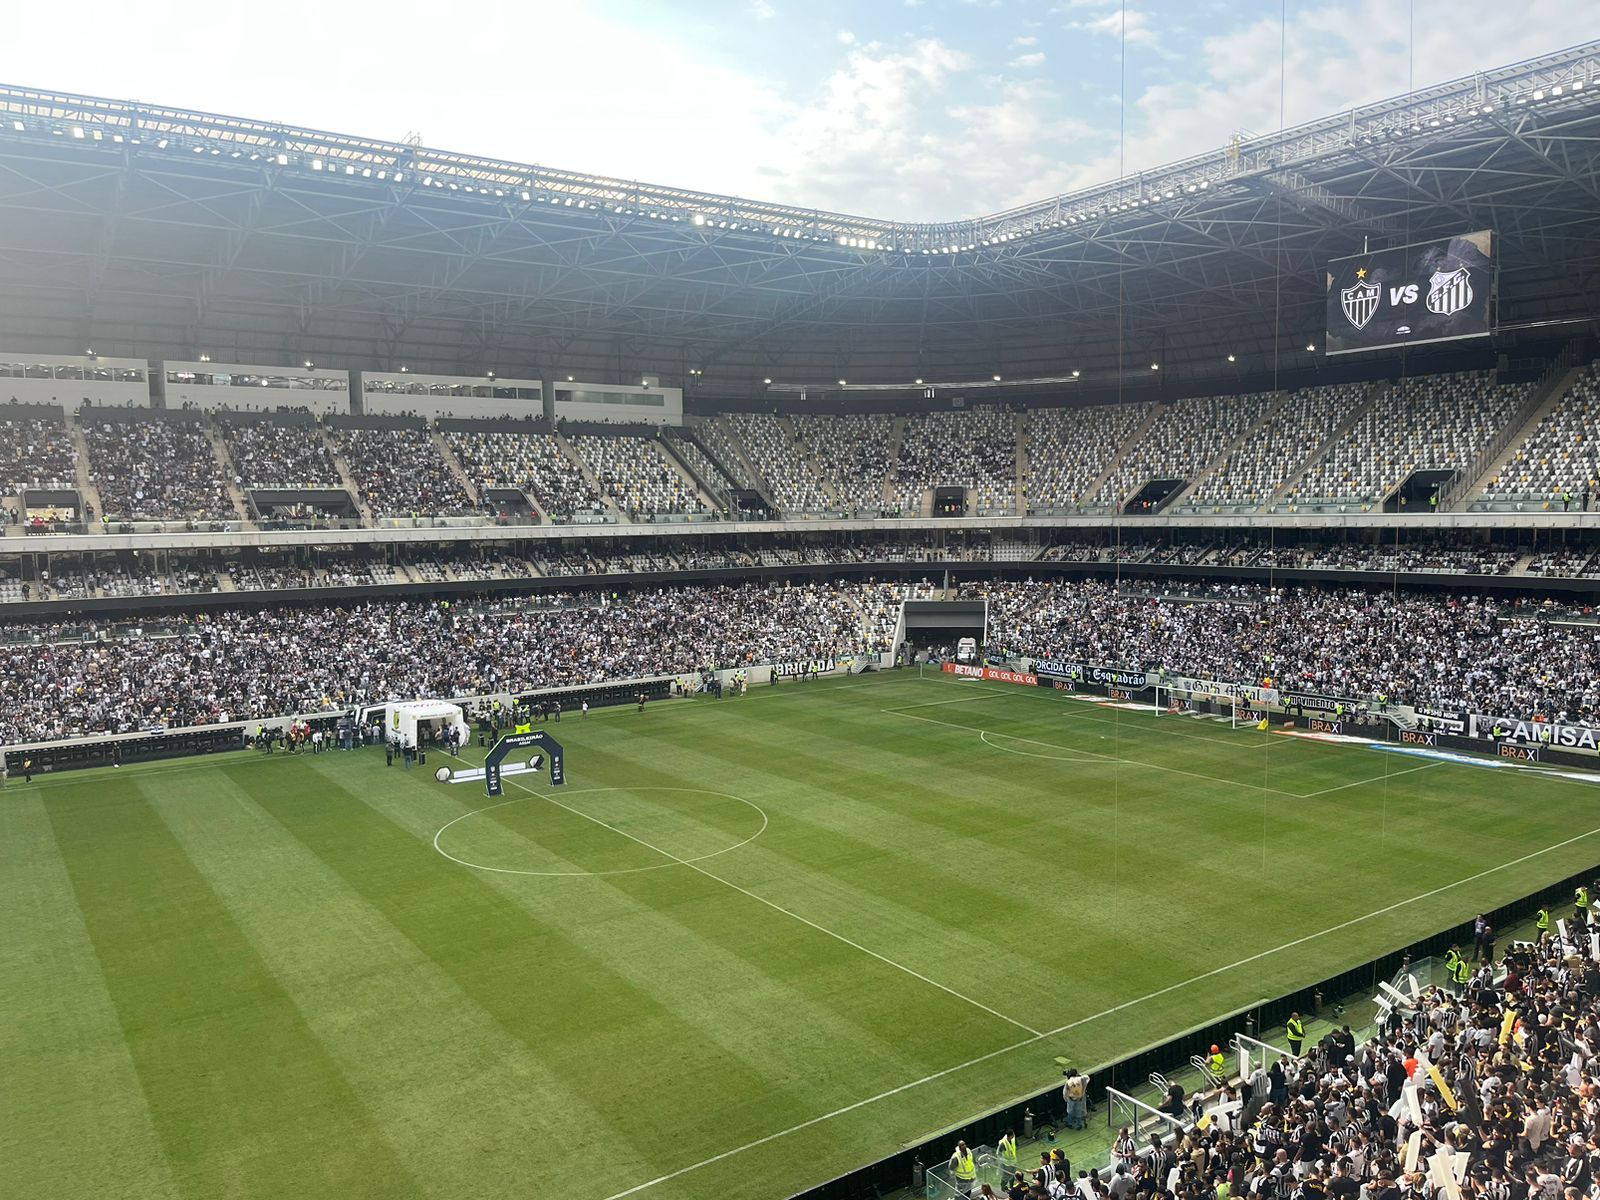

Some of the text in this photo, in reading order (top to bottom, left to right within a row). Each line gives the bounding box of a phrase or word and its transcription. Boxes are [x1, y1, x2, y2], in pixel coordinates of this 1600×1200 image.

[1347, 288, 1375, 300] CAM
[1390, 284, 1419, 306] VS
[954, 664, 983, 678] BETANO
[988, 670, 1037, 685] GOL GOL GOL GOL
[1092, 668, 1145, 686] Esqadrão
[1055, 681, 1073, 692] BRAX
[1225, 684, 1261, 701] Meal
[1110, 689, 1131, 700] BRAX
[1235, 709, 1260, 722] BRAX
[1311, 720, 1339, 734] BRAX
[1495, 718, 1597, 749] CAMISA
[1402, 731, 1434, 746] BRAX
[1501, 745, 1535, 761] BRAX
